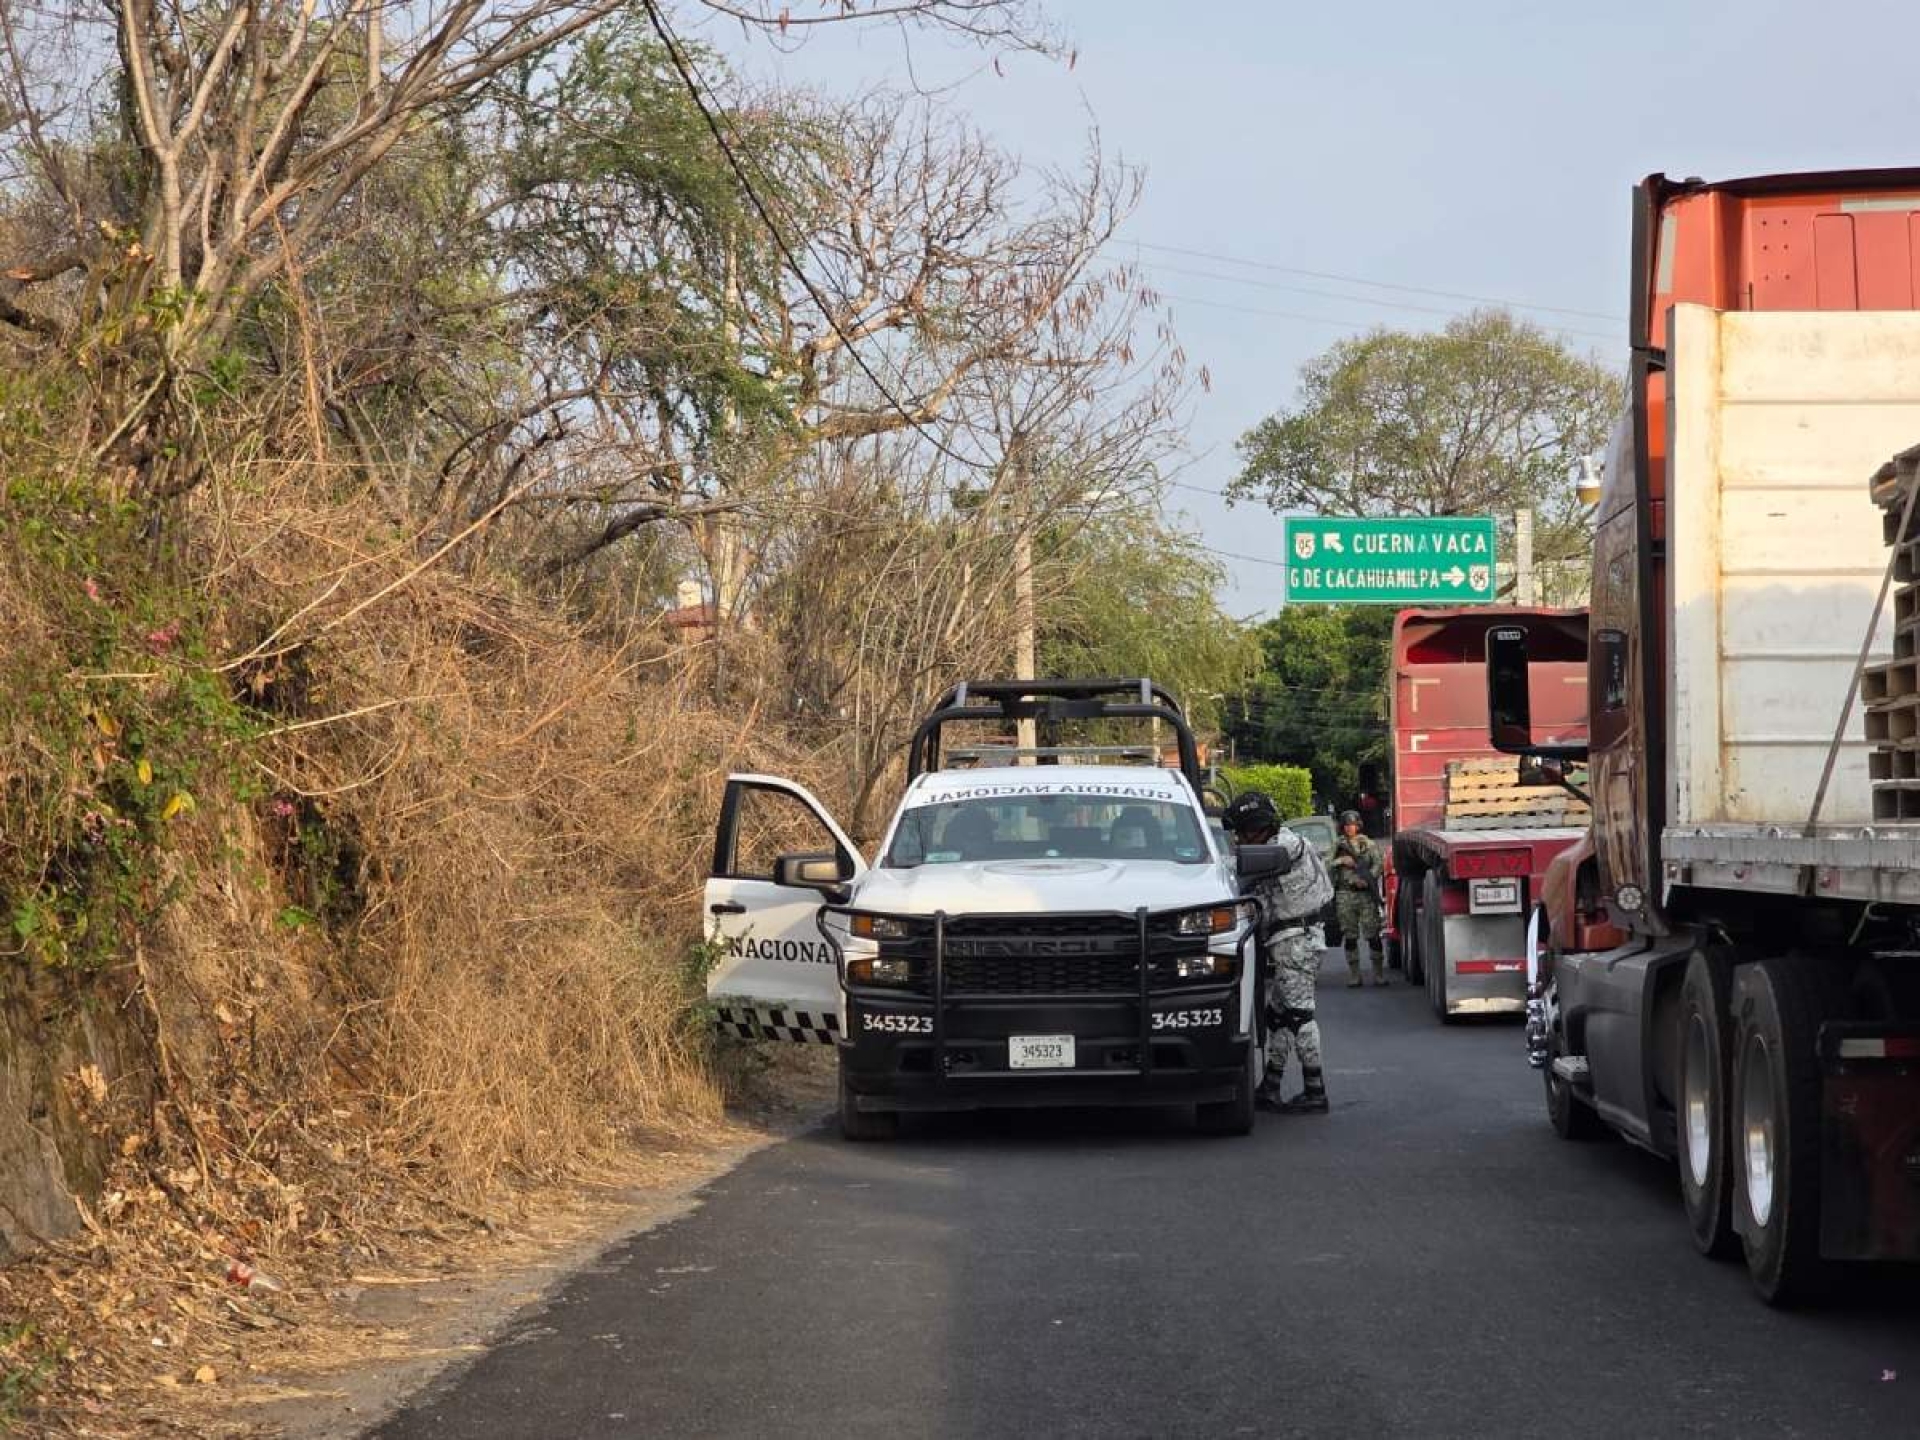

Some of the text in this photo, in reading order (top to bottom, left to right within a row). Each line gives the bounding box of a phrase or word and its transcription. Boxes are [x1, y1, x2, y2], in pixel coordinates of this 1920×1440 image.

[1353, 533, 1487, 553] CUERNAVACA
[1303, 567, 1321, 588] DE
[1325, 567, 1440, 588] CACAHUAMILPA
[729, 936, 837, 964] NACIONA
[863, 1013, 934, 1033] 345323
[1151, 1008, 1223, 1030] 345323
[1021, 1044, 1062, 1058] 345323
